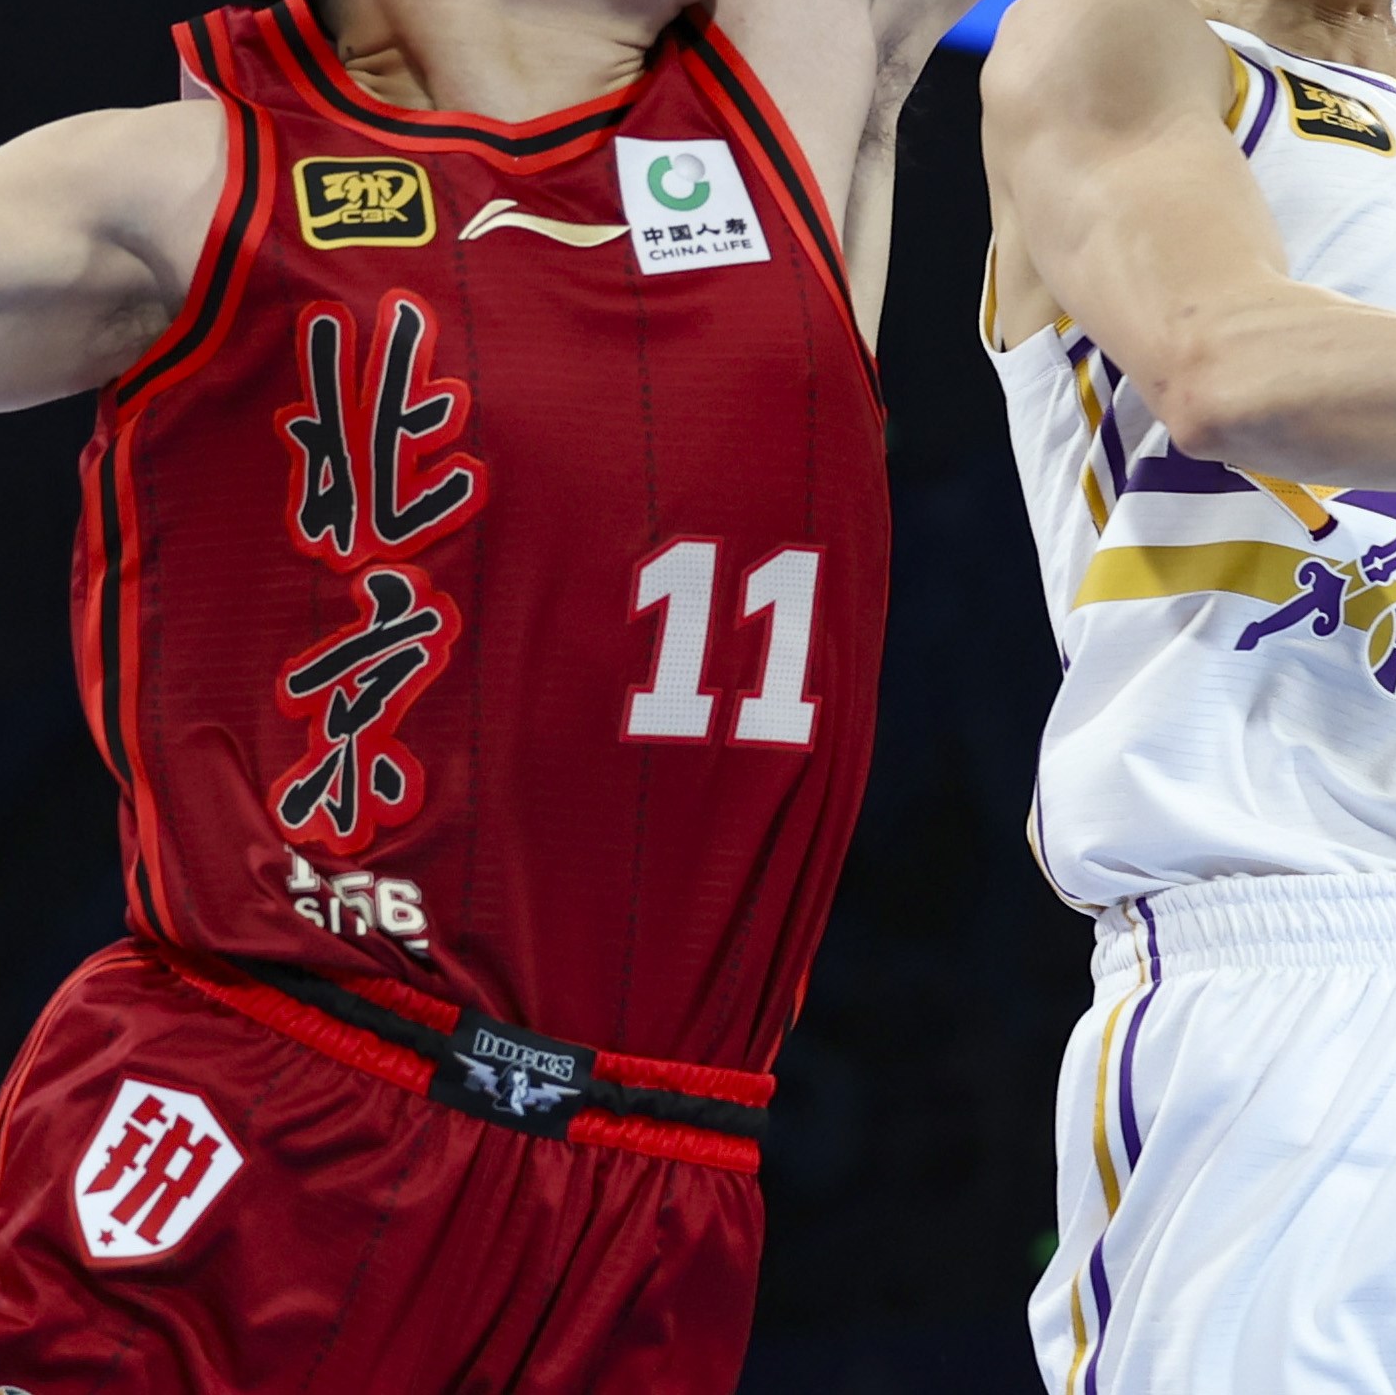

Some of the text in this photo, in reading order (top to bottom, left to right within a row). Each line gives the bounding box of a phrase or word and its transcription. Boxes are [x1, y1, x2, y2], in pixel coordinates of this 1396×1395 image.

[340, 208, 409, 224] CBA
[642, 217, 748, 246] 中国人寿
[649, 238, 753, 261] CHINA LIFE
[277, 298, 477, 838] 北京
[625, 540, 820, 745] 11
[472, 1028, 576, 1082] DUCKS
